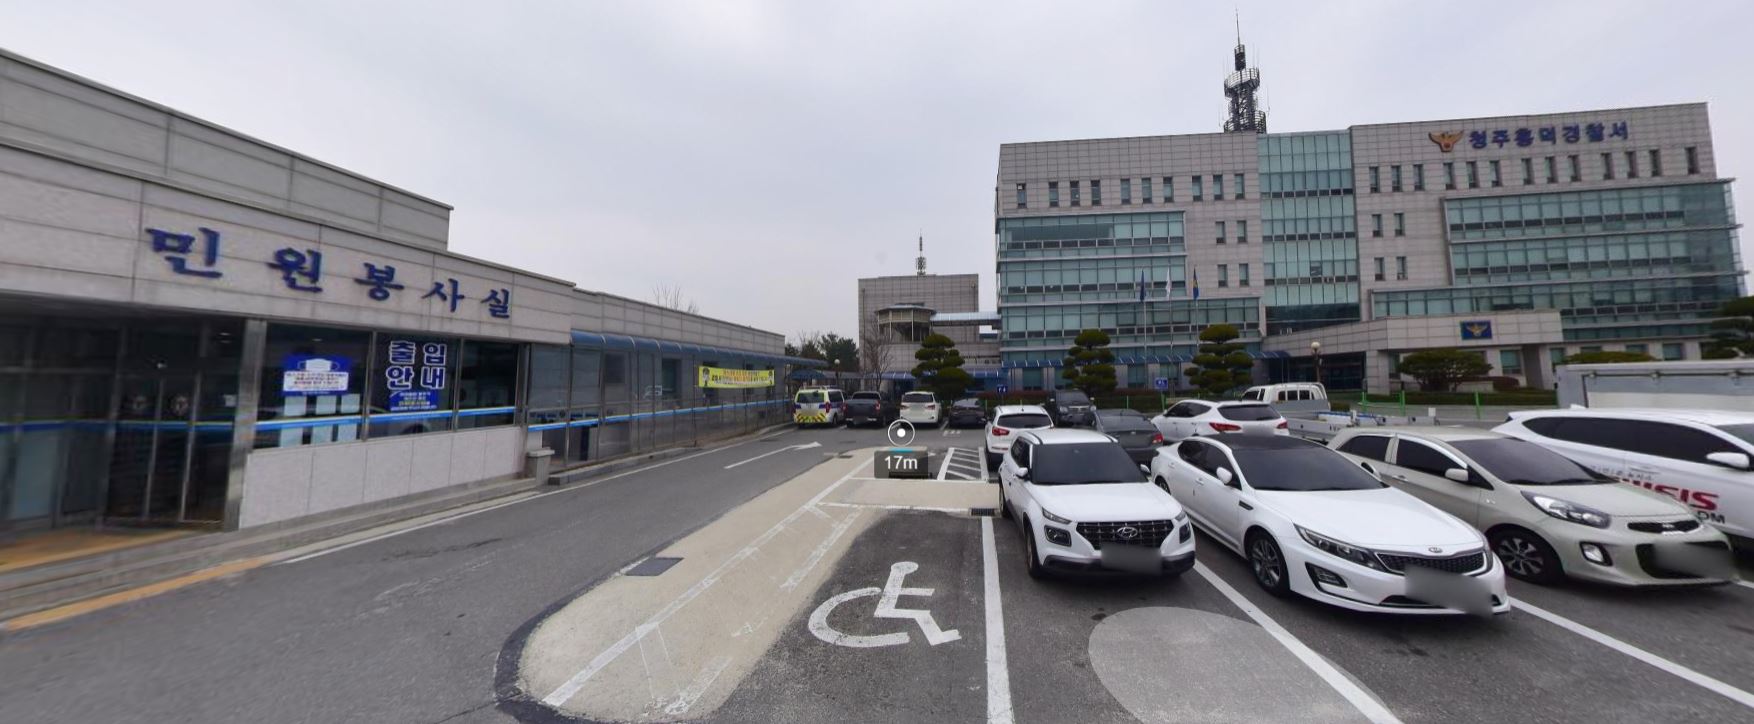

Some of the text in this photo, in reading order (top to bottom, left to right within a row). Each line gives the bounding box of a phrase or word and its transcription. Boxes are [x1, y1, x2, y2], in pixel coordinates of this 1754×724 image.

[146, 227, 511, 318] 민원봉사실
[386, 340, 447, 365] 출입
[384, 366, 447, 391] 안내
